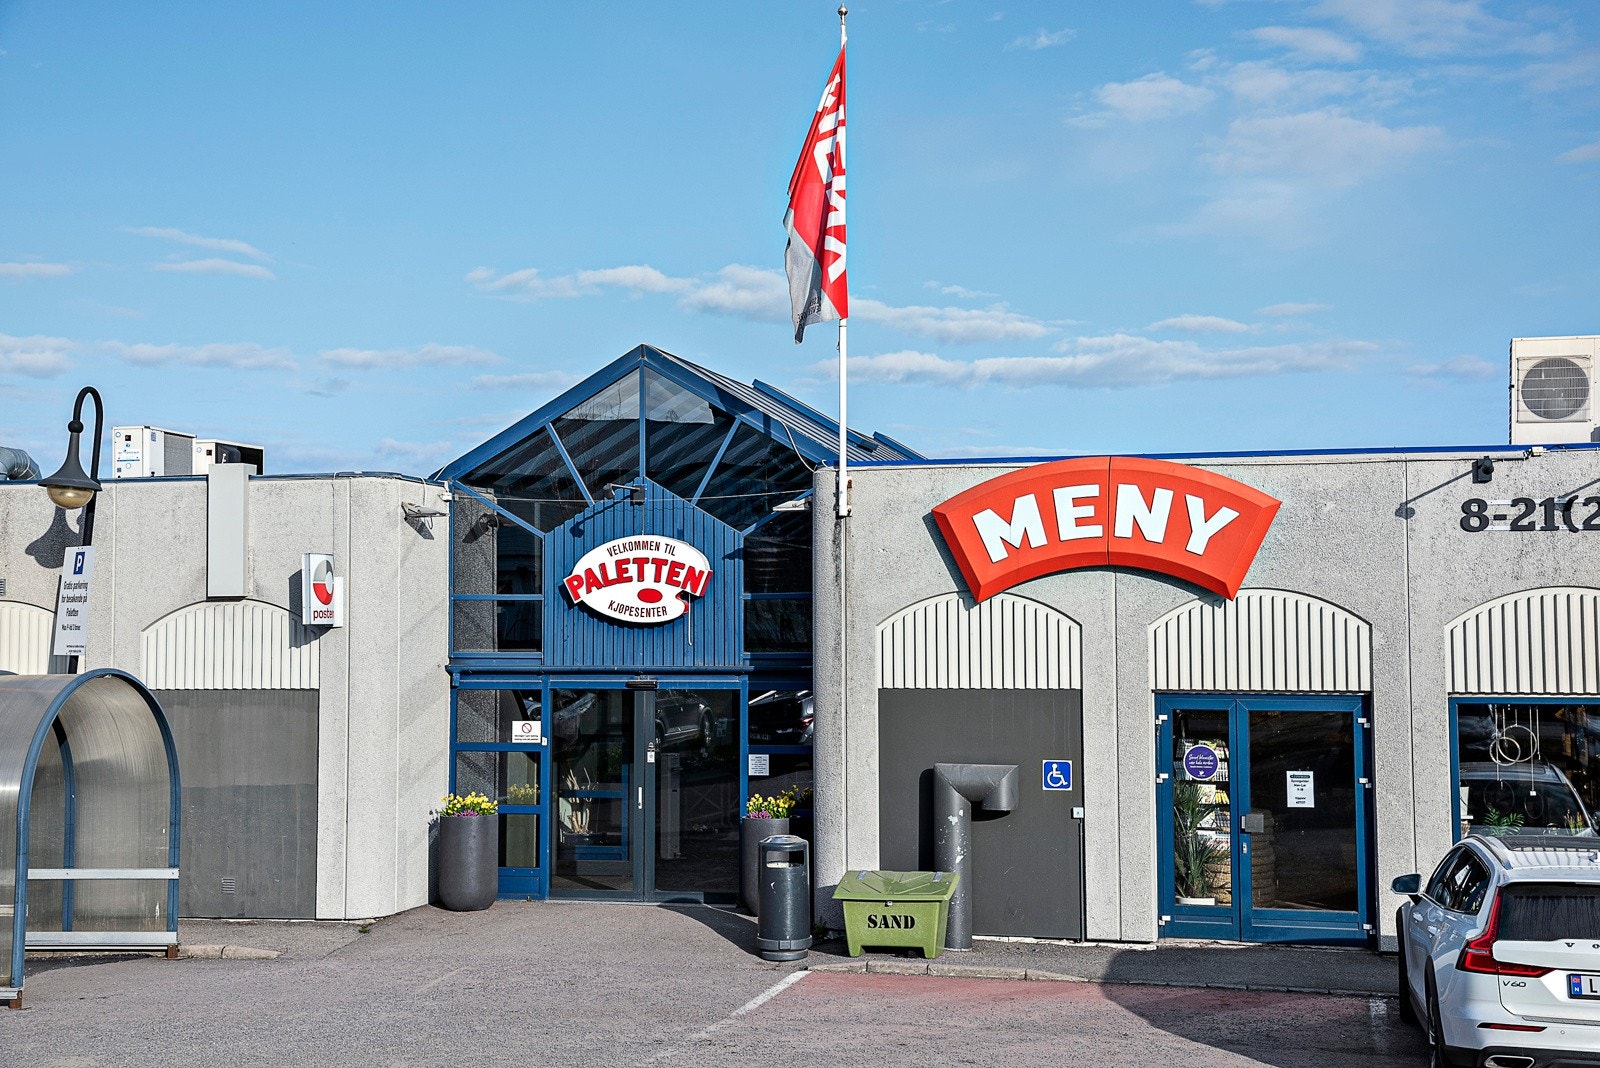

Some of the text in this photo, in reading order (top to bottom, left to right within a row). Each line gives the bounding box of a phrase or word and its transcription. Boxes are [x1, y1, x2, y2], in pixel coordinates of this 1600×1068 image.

[972, 484, 1240, 563] MENY
[606, 540, 676, 557] VELKOMMEN TIL
[76, 555, 83, 572] P
[565, 557, 704, 601] PALETTEN
[608, 600, 668, 618] KJØPESENTER
[867, 914, 915, 929] SAND
[1502, 980, 1527, 988] V60
